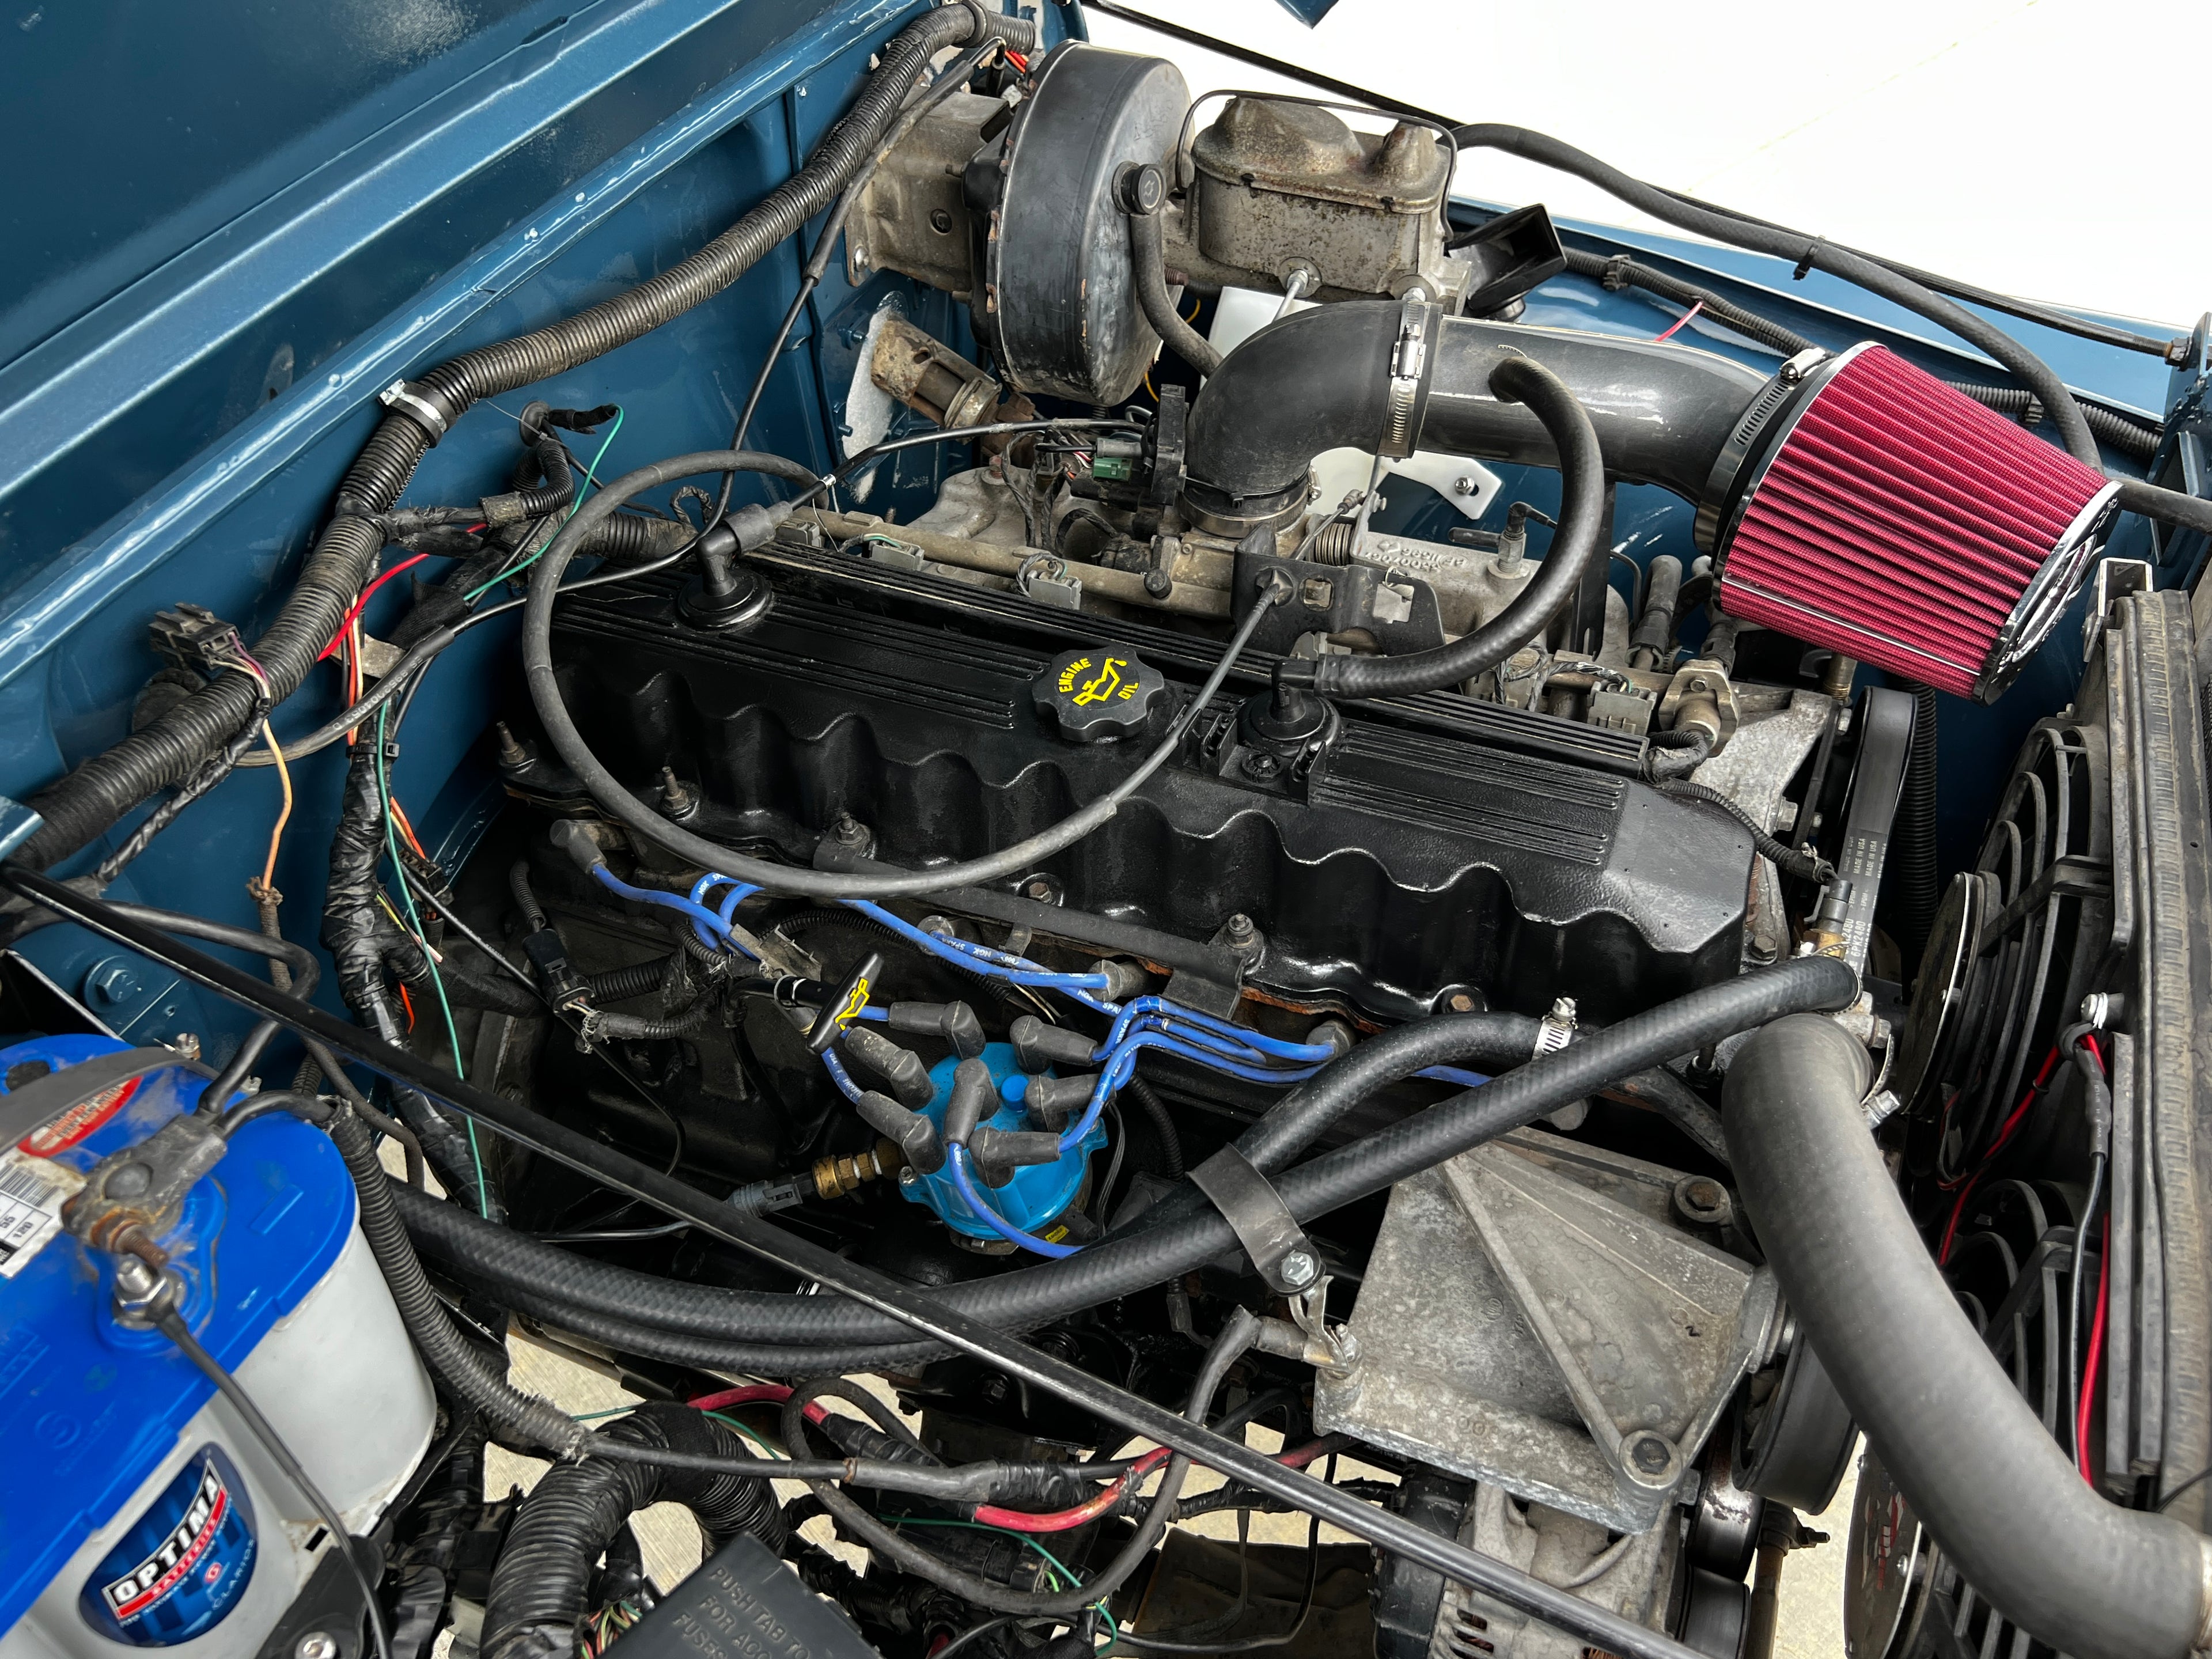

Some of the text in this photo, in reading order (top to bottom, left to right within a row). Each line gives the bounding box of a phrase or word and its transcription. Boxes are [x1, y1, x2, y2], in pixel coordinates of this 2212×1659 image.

[1058, 658, 1092, 693] ENGINE
[1118, 683, 1139, 700] OIL
[1853, 858, 1862, 874] MADE
[1858, 838, 1866, 850] USA
[1869, 840, 1878, 852] USA
[1865, 860, 1874, 877] MADE
[972, 947, 991, 957] NGK
[1850, 921, 1866, 957] 6PK2480
[113, 1474, 218, 1604] OPTIMA
[211, 1538, 255, 1610] CLARIOS
[699, 1595, 736, 1634] FOR
[709, 1566, 757, 1613] PUSH
[753, 1604, 787, 1642] TAB
